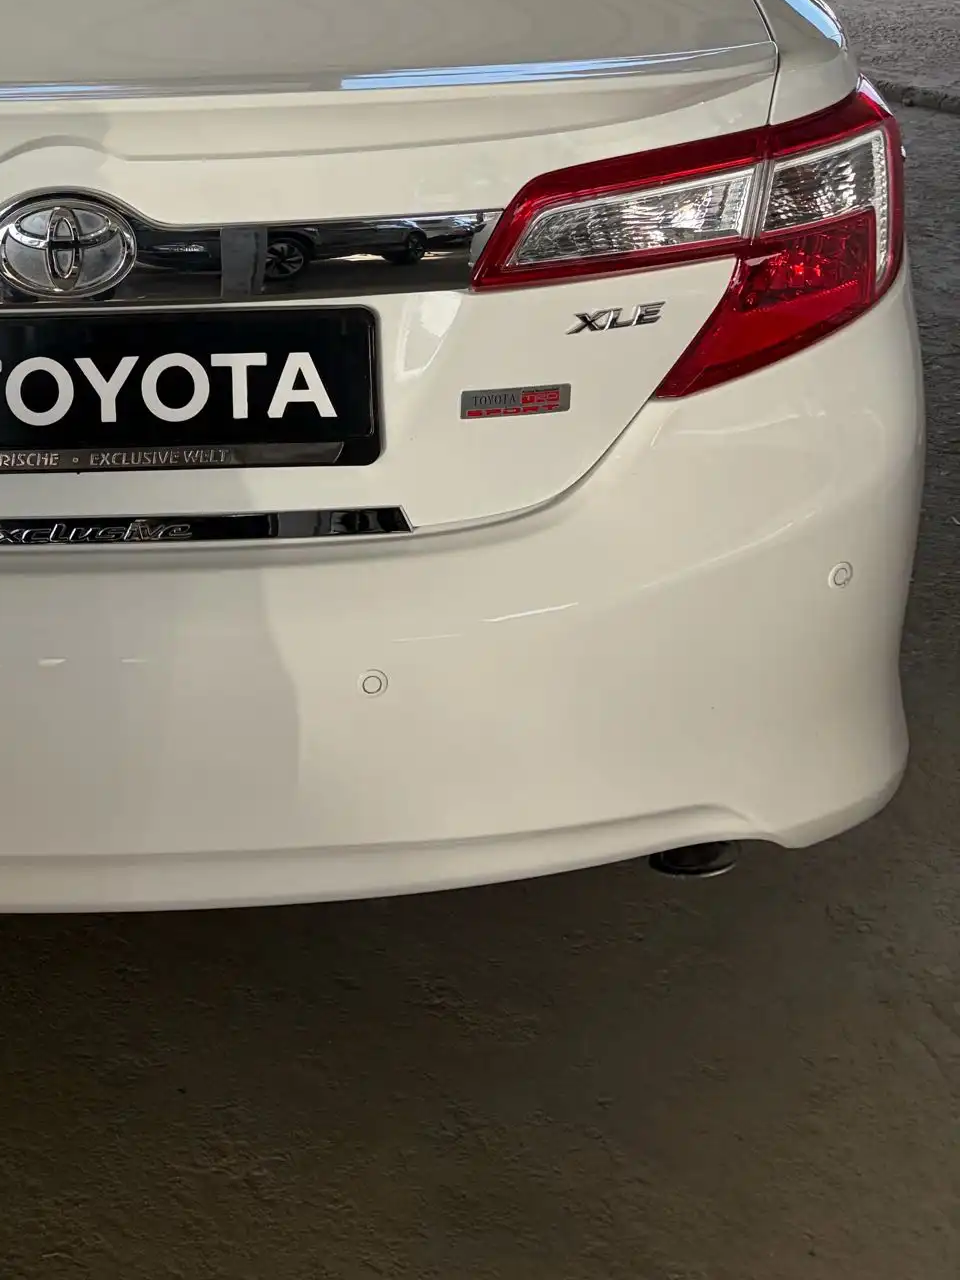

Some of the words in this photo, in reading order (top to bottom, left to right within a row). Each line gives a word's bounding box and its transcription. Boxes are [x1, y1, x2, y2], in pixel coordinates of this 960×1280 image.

[565, 301, 666, 335] XLE
[473, 393, 517, 407] TOYOTA
[467, 404, 560, 417] SPORT
[90, 451, 180, 466] EXCLUSIVE
[184, 449, 230, 464] WELT
